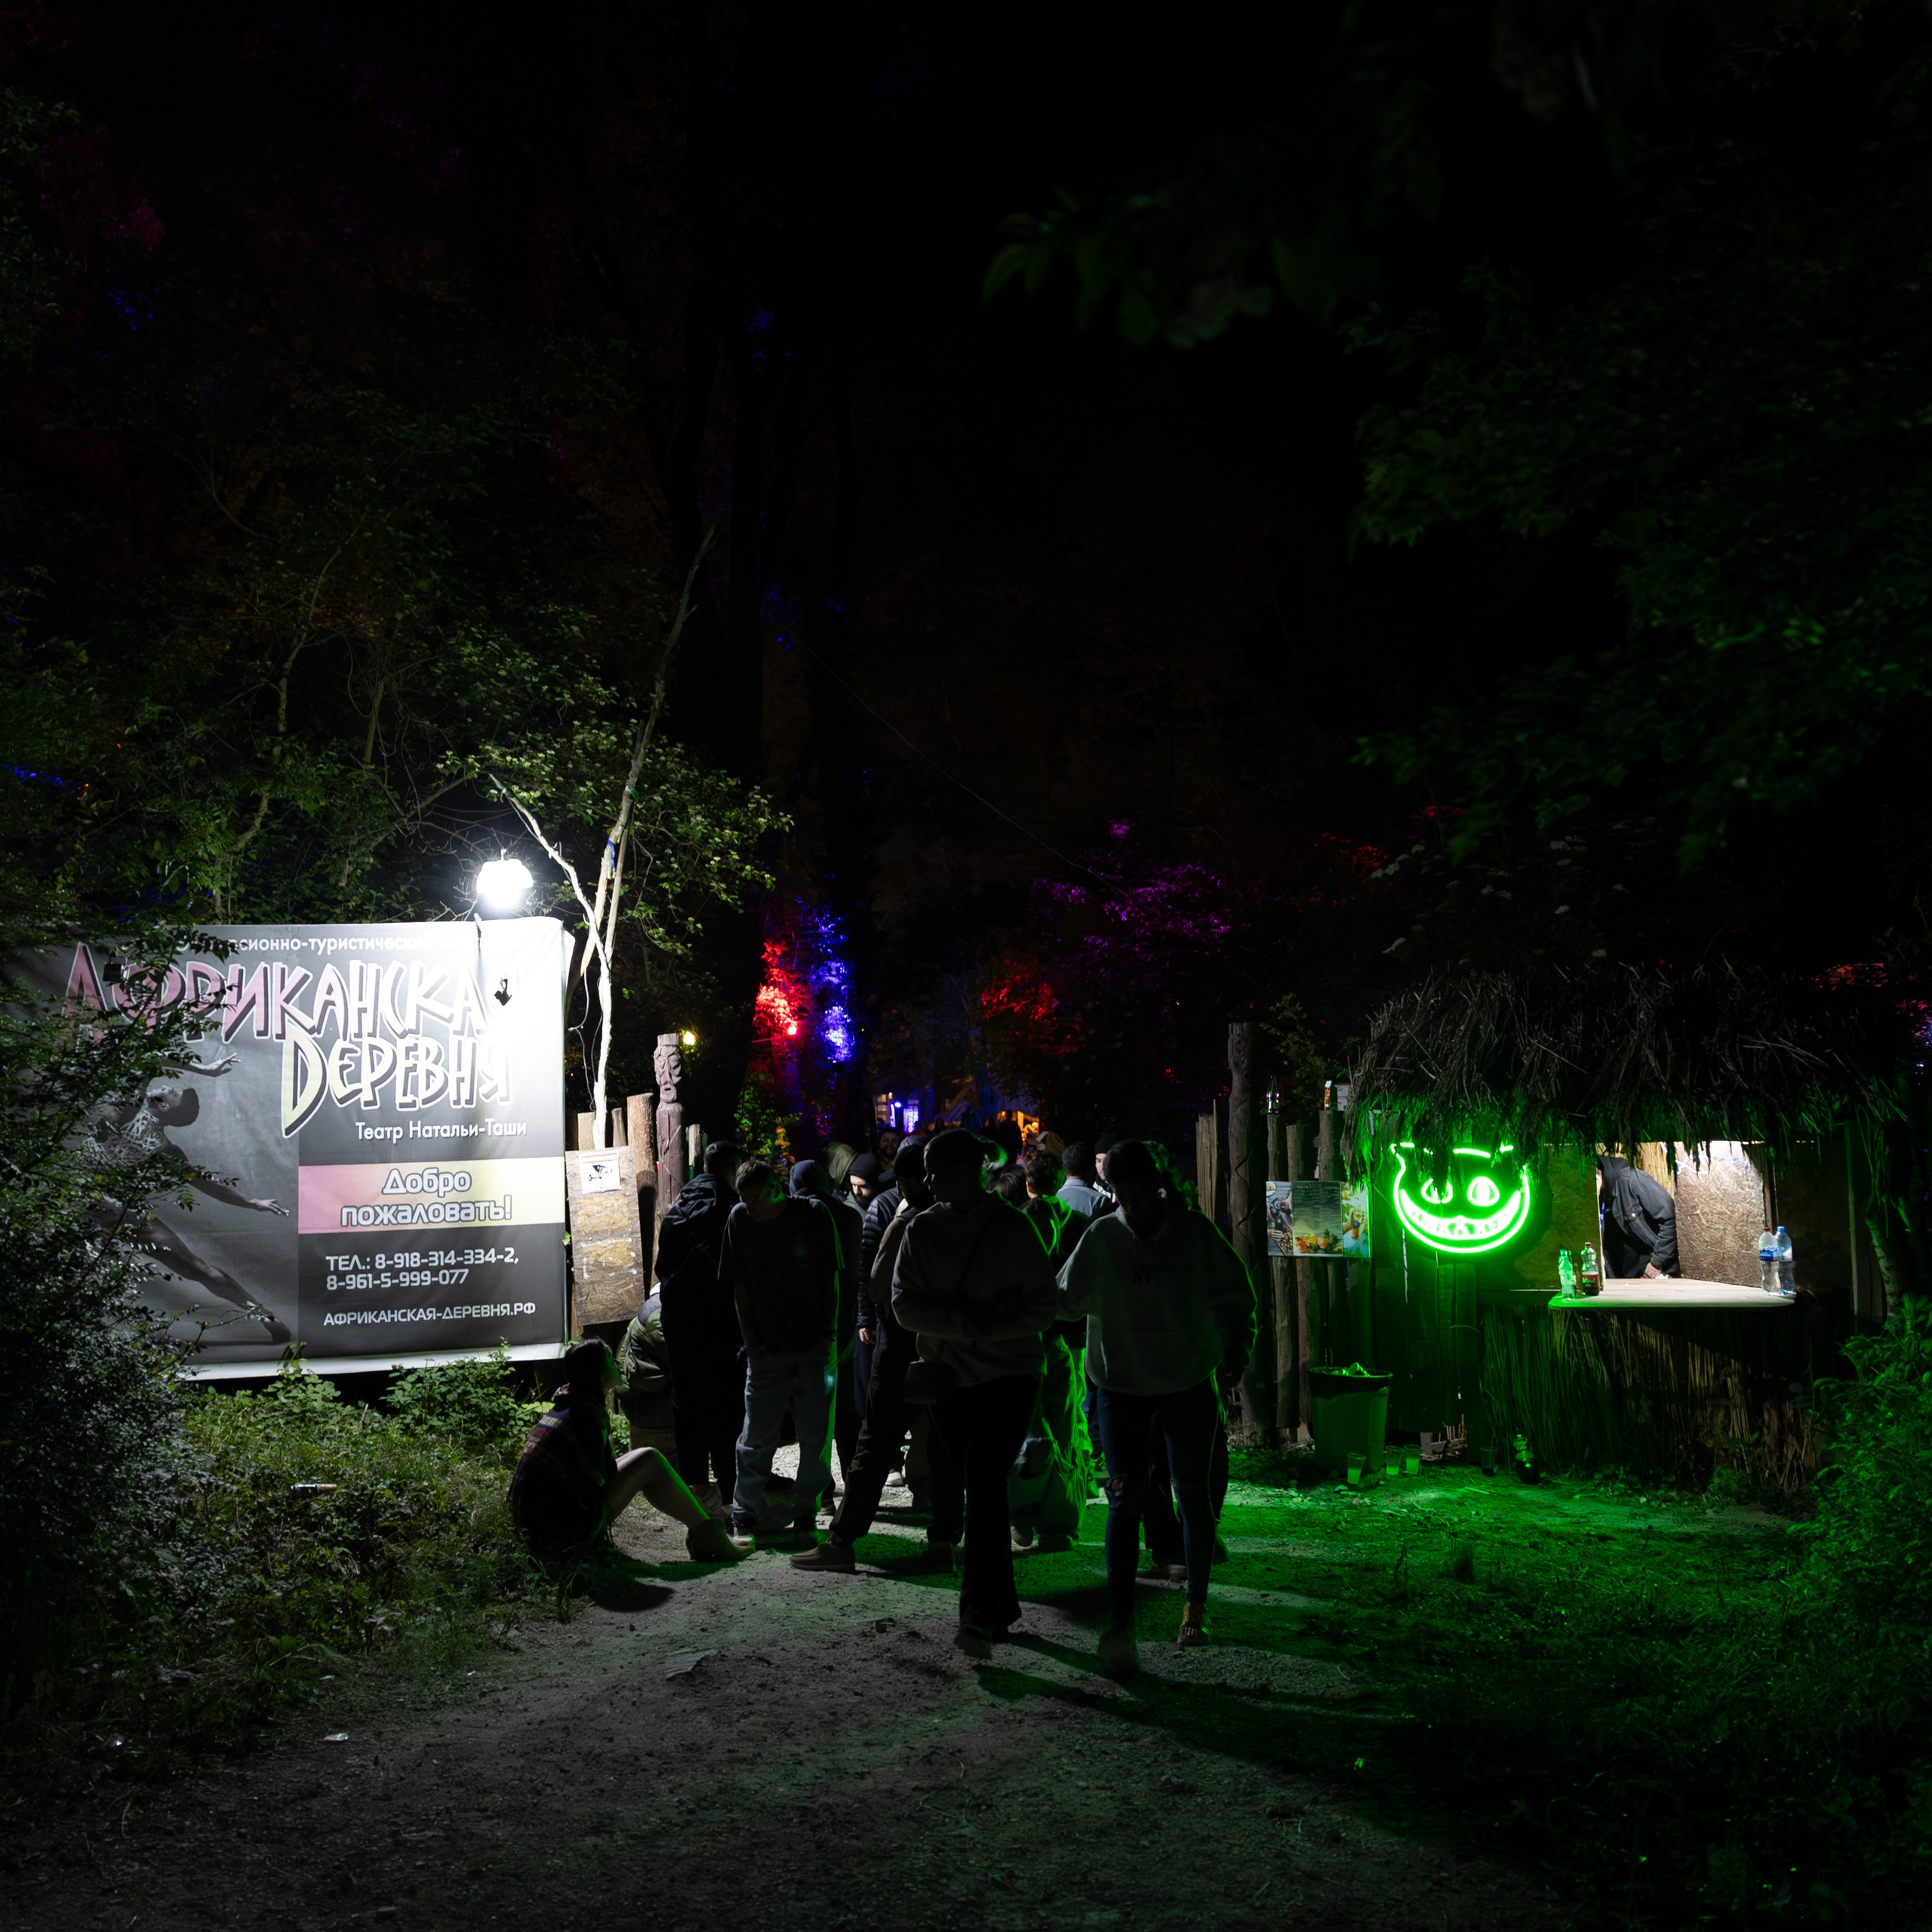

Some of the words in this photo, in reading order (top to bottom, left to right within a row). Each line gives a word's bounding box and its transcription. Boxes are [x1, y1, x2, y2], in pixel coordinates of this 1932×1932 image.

[355, 1121, 403, 1144] Театр
[409, 1118, 527, 1140] Натальи-Таши
[382, 1168, 472, 1198] Добро
[340, 1194, 512, 1227] пожаловать!
[325, 1254, 371, 1272] ТЕЛ.:
[374, 1247, 519, 1270] 8-918-314-334-2,
[326, 1268, 469, 1291] 8-961-5-999-077
[323, 1301, 536, 1327] АФРИКАНСКАЯ-ДЕРЕВНЯ.РФ
